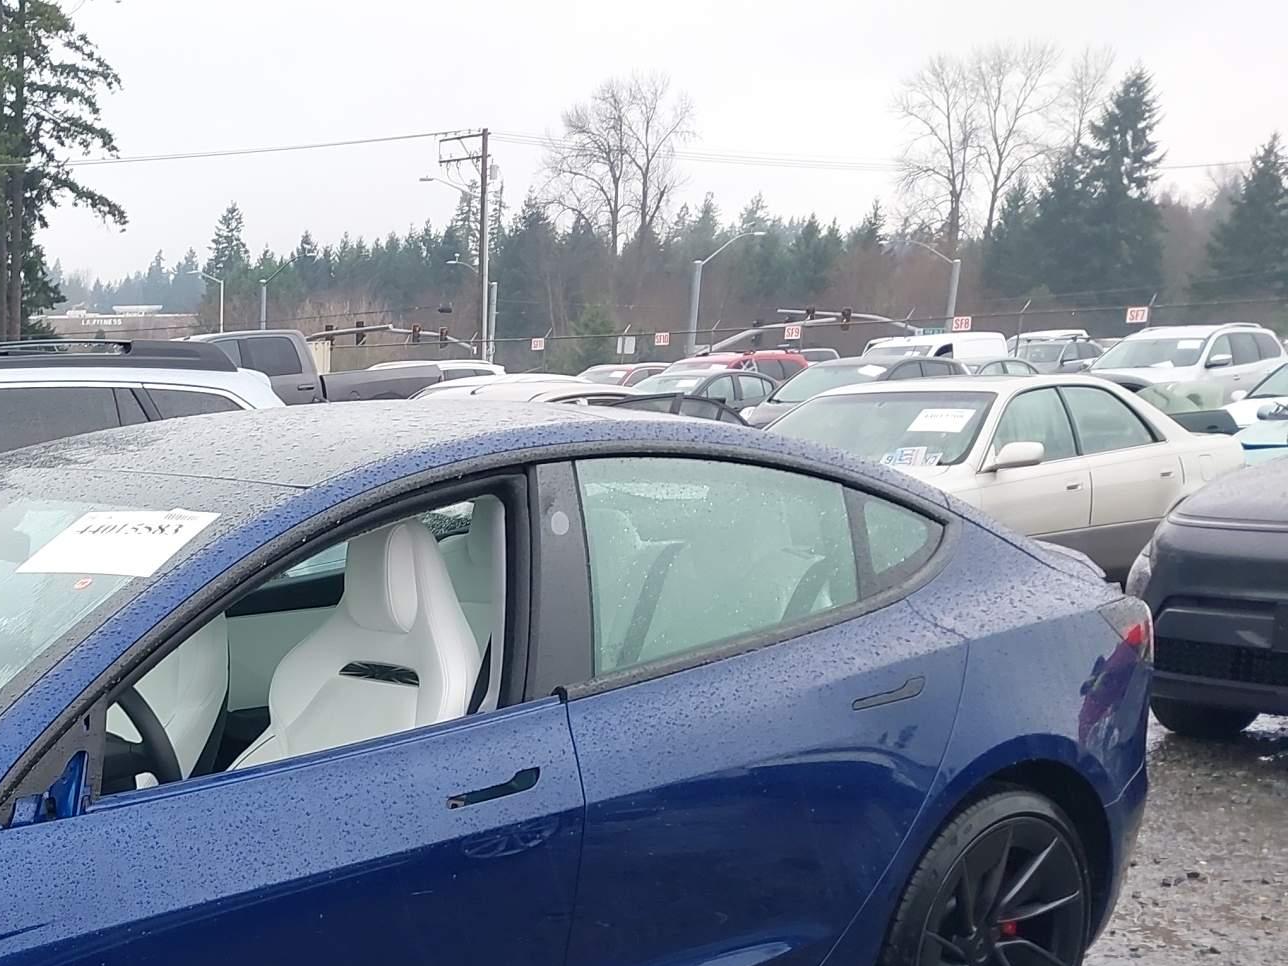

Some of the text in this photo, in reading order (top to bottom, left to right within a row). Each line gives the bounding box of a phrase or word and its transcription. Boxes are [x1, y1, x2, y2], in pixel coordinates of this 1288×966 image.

[1128, 309, 1146, 321] SF7
[954, 318, 970, 329] SF8
[785, 327, 800, 338] SF9
